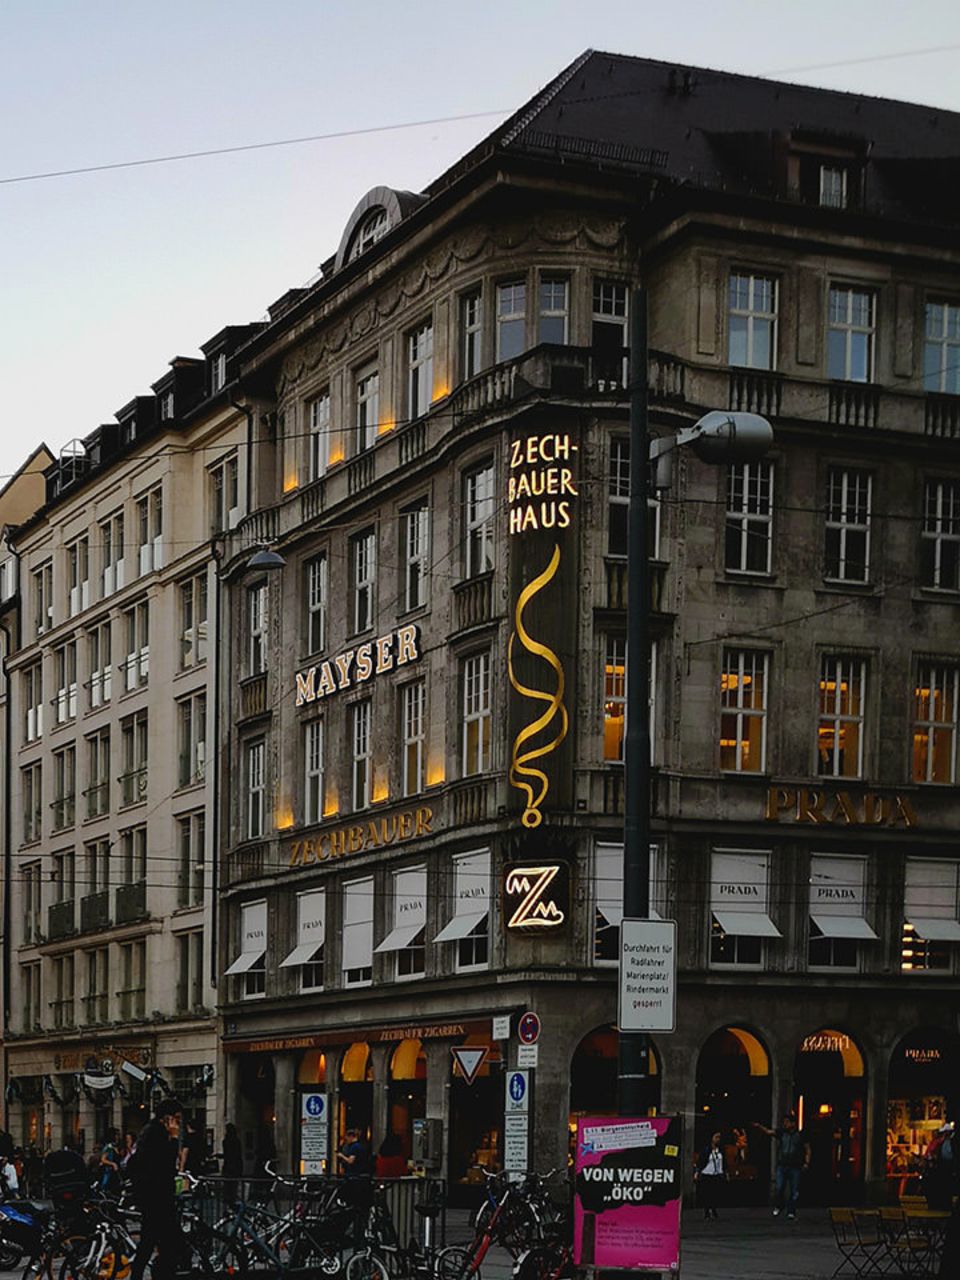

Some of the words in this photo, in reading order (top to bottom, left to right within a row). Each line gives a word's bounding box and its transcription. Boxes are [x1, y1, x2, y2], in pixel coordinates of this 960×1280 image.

[510, 434, 578, 468] ZECH-
[508, 468, 579, 503] BAUER
[509, 501, 571, 535] HAUS
[295, 624, 419, 707] MAYSER
[766, 785, 919, 828] PRADA
[289, 806, 433, 868] ZECHBAUER
[459, 887, 485, 898] PRADA
[720, 885, 759, 896] PRADA
[817, 888, 856, 899] PRADA
[399, 901, 423, 912] PRADA
[302, 919, 322, 930] PRADA
[623, 944, 660, 953] Durchfahrt
[662, 945, 673, 954] für
[630, 957, 665, 967] Radfahrer
[626, 984, 670, 994] Rindermarkt
[632, 1000, 663, 1009] gesperrt
[582, 1167, 614, 1182] VON
[617, 1168, 675, 1183] WEGEN
